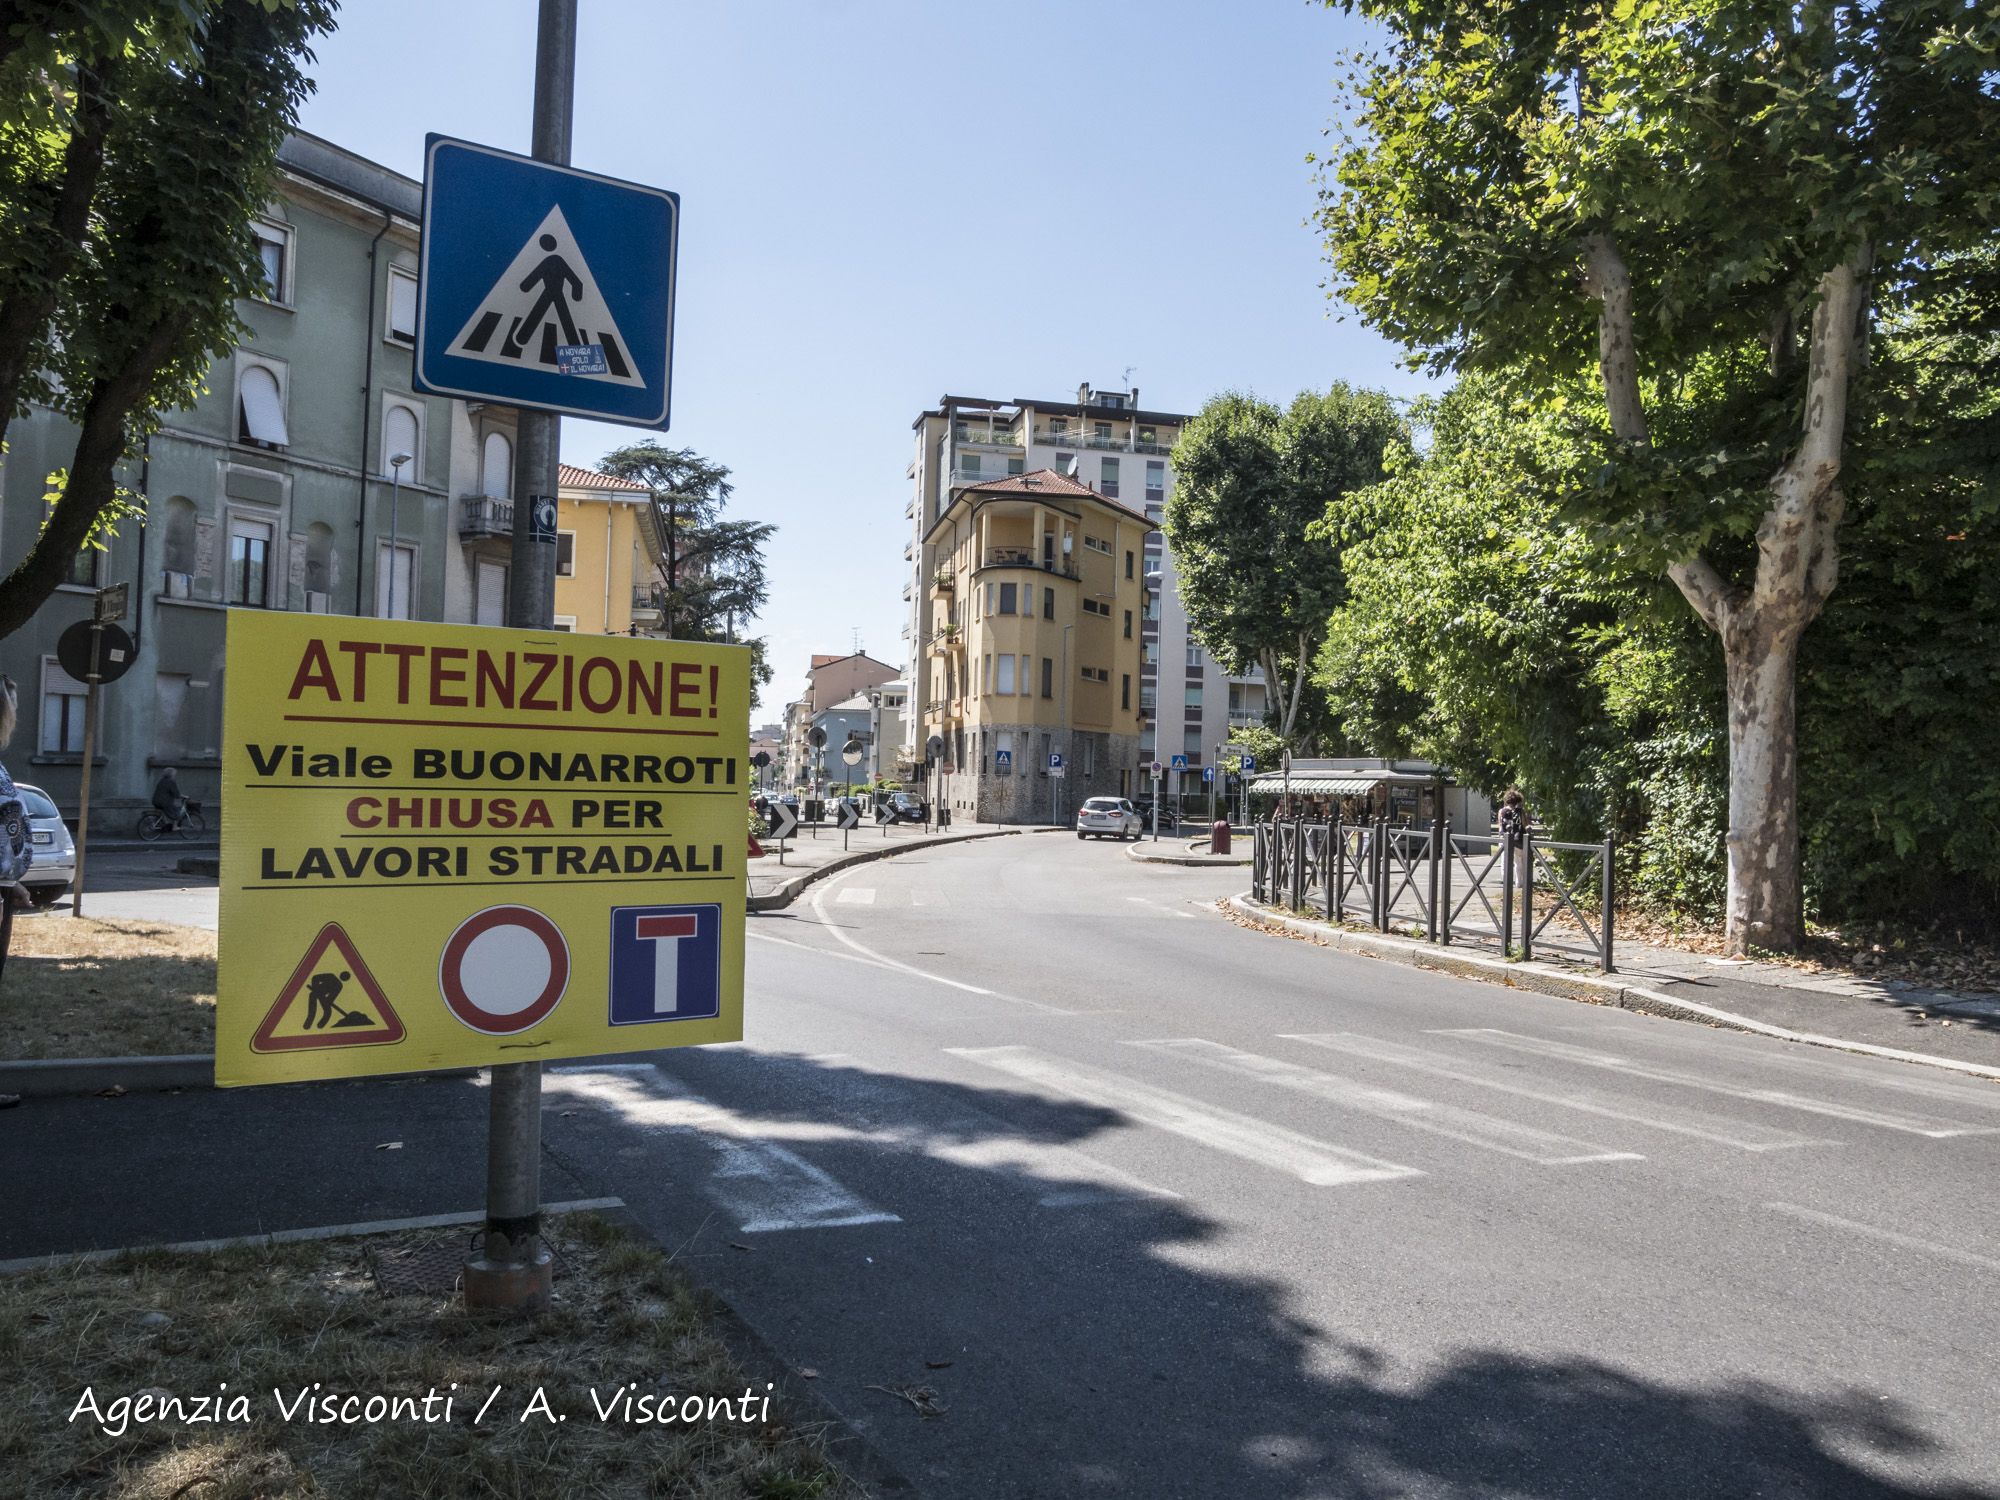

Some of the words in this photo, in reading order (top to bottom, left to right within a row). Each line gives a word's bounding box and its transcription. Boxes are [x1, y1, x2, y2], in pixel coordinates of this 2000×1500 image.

[559, 348, 565, 357] A
[565, 348, 591, 356] NOVARA
[571, 357, 588, 365] SOLO
[571, 365, 578, 373] IL
[579, 364, 605, 373] NOVARA!
[287, 638, 720, 720] ATTENZIONE!
[245, 743, 393, 779] Viale
[413, 748, 737, 786] BUONARROTI
[1051, 755, 1060, 766] P
[1243, 757, 1252, 769] P
[346, 796, 554, 829] CHIUSA
[571, 799, 664, 829] PER
[260, 846, 469, 880] LAVORI
[488, 844, 724, 876] STRADALI
